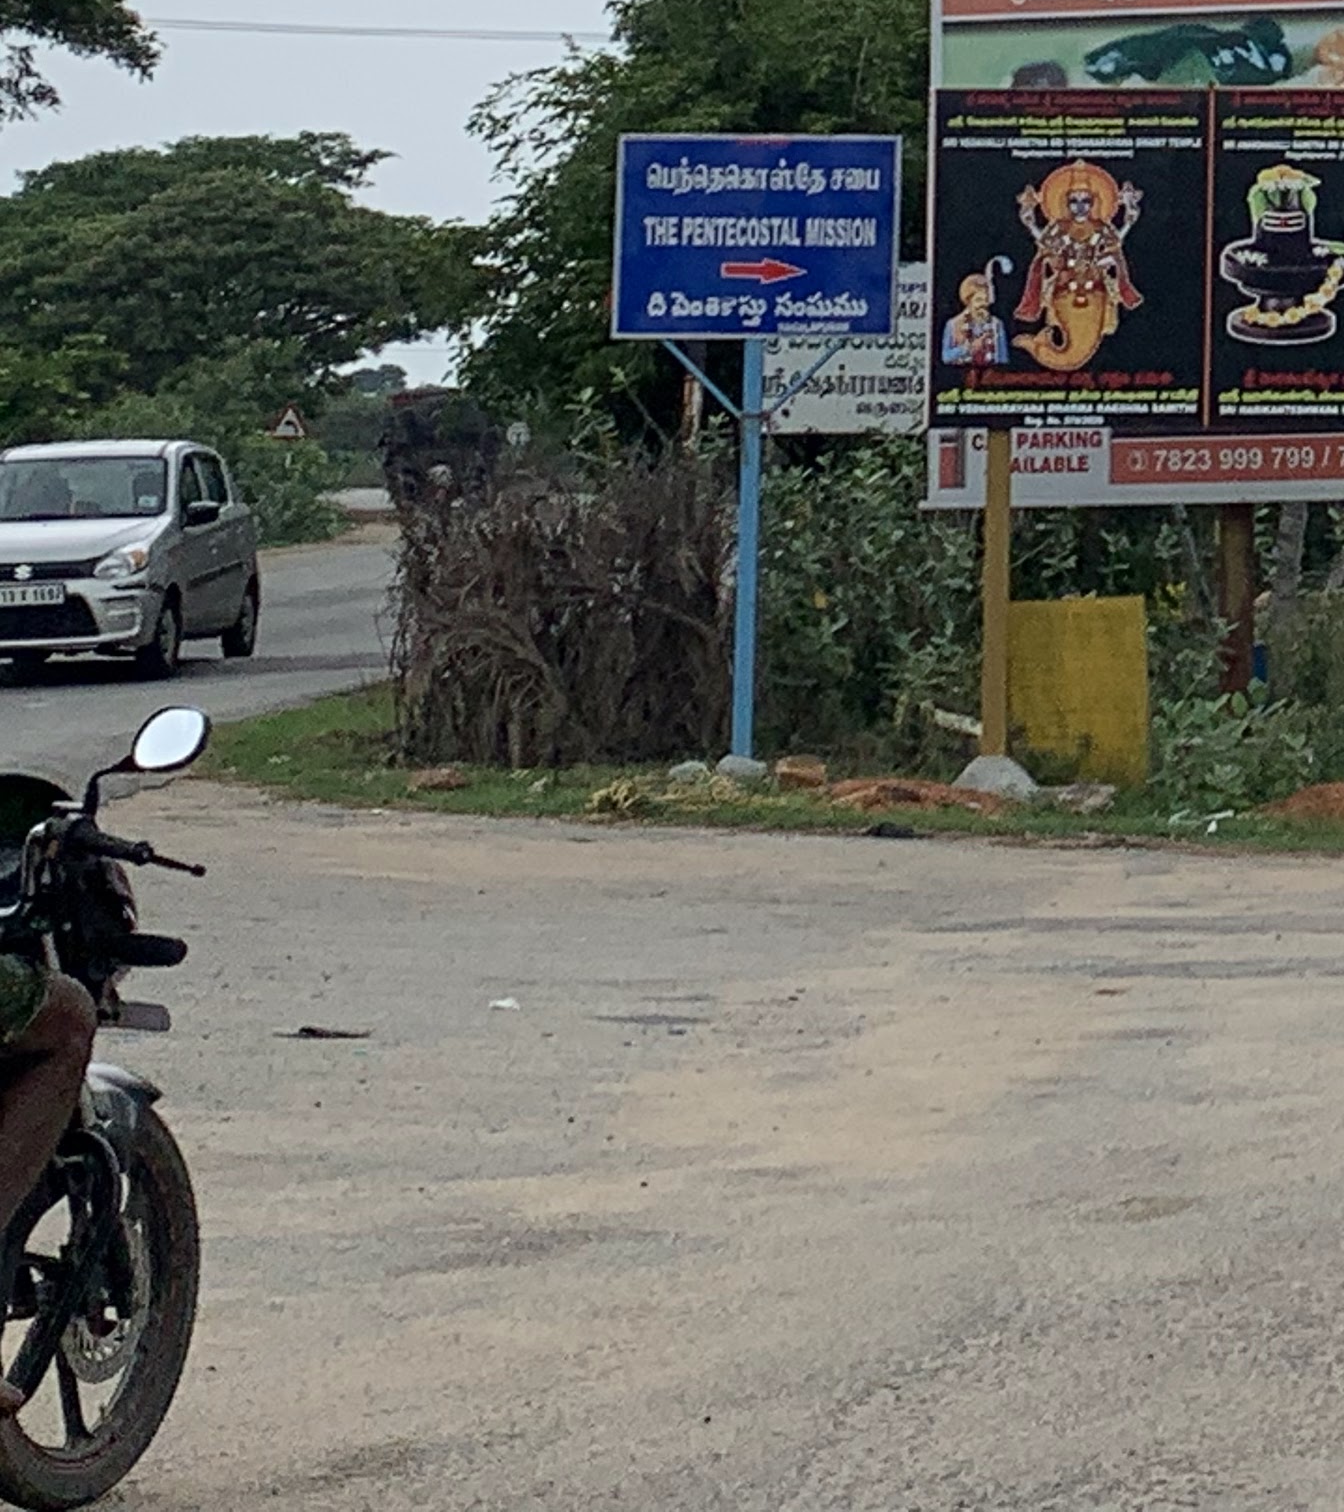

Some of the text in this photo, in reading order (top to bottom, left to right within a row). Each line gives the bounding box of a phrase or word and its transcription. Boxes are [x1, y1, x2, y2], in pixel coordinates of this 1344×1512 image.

[643, 216, 877, 247] THE PENTECOSTAL MISSION
[1016, 431, 1103, 450] PARKING
[1153, 448, 1212, 472] 7823
[1218, 446, 1263, 471] 999
[1270, 445, 1315, 470] 799
[1321, 444, 1331, 468] /
